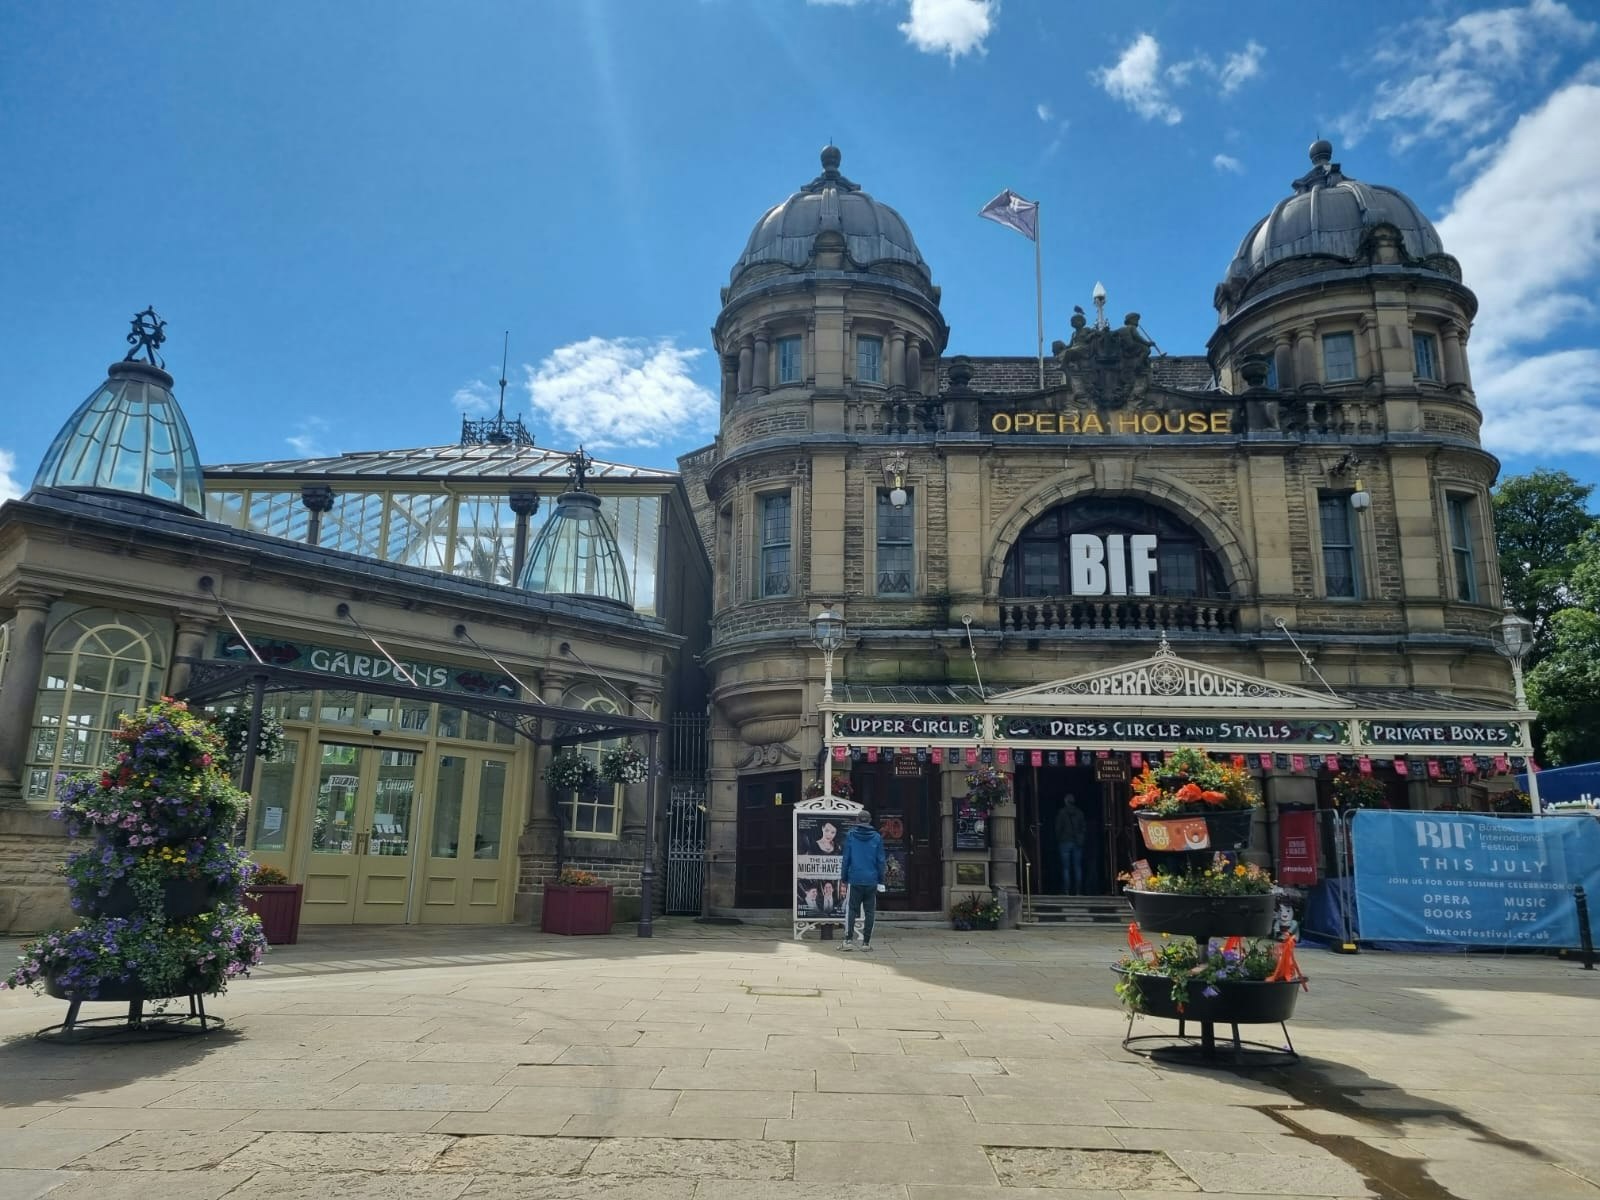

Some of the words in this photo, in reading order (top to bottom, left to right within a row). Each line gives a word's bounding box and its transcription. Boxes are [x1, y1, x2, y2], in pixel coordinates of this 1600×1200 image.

[991, 412, 1105, 434] OPERA
[1117, 412, 1233, 434] HOUSE
[1069, 533, 1159, 596] BIF
[1089, 670, 1151, 696] OPERA
[1184, 667, 1245, 697] HOUSE
[849, 718, 905, 733] UPPER
[911, 717, 970, 735] CIRCLE
[1050, 720, 1108, 737] DRESS
[1113, 720, 1181, 738] CIRCLE
[1219, 722, 1292, 739] STALLS
[1373, 725, 1445, 741] PRIVATE
[1451, 726, 1509, 742] BOXES
[1415, 820, 1475, 849] BIF
[1479, 823, 1514, 832] Buxton
[1479, 833, 1544, 842] International
[1481, 842, 1519, 852] Festival
[1420, 857, 1474, 871] THIS
[1490, 859, 1545, 873] JULY
[1389, 877, 1408, 885] JOIN
[1412, 878, 1422, 886] US
[1426, 879, 1442, 887] FOR
[1447, 879, 1464, 887] OUR
[1468, 881, 1504, 889] SUMMER
[1507, 882, 1564, 891] CELEBRATION
[1424, 894, 1470, 905] OPERA
[1504, 897, 1547, 908] MUSIC
[1424, 909, 1472, 920] BOOKS
[1504, 911, 1537, 921] JAZZ
[1425, 926, 1550, 940] buxtonfestival.co.uk
